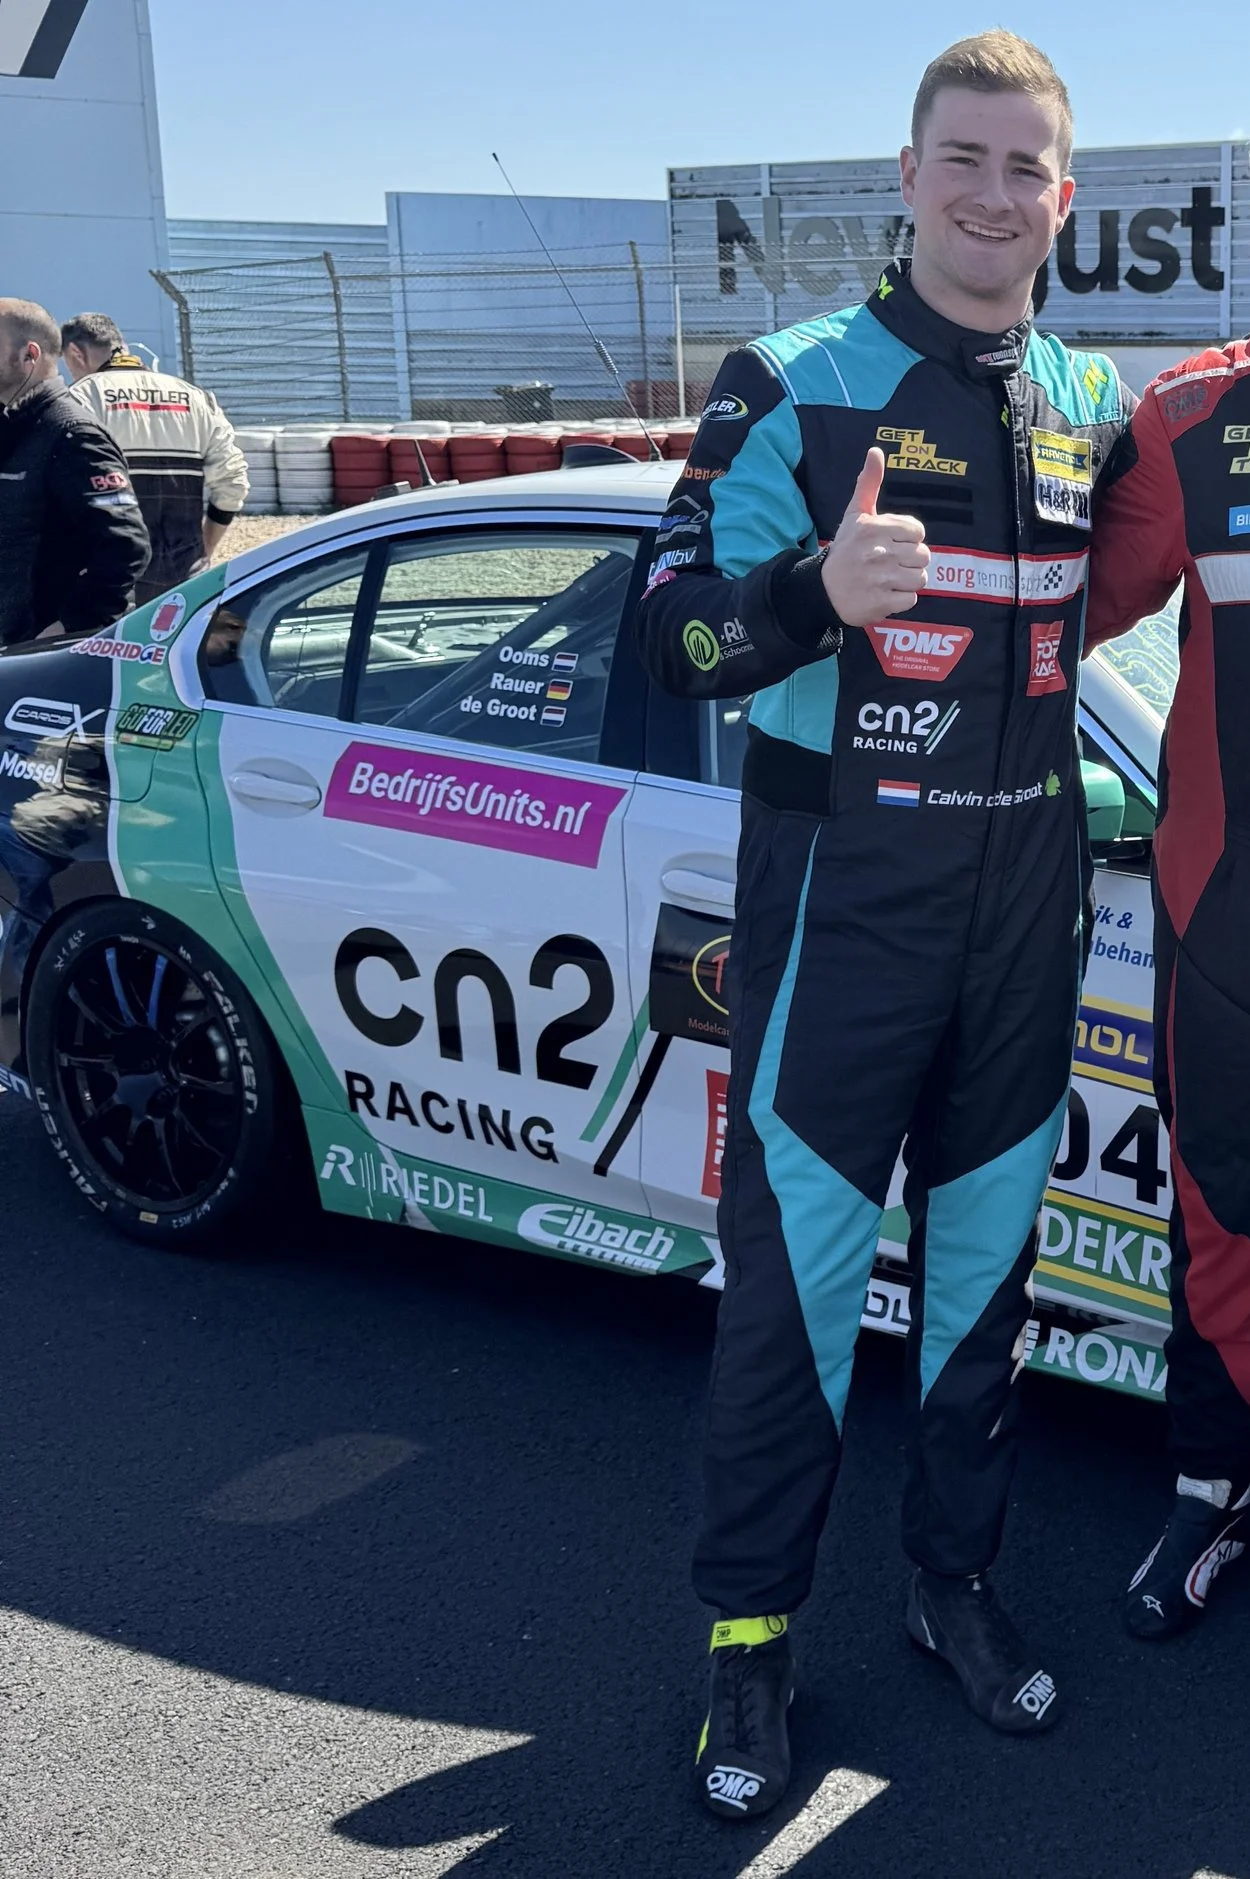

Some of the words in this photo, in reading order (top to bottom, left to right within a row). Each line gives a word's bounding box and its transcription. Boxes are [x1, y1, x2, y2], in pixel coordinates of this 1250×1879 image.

[878, 429, 921, 442] GET
[905, 444, 930, 455] ON
[890, 455, 962, 474] TRACK
[936, 565, 975, 588] sorg
[874, 626, 963, 657] TOMS
[499, 645, 550, 667] Ooms
[490, 673, 544, 695] Rauer
[460, 695, 483, 713] de
[486, 699, 537, 721] Groot
[858, 700, 940, 737] cn2
[852, 736, 918, 754] RACING
[0, 751, 63, 785] Mossel
[349, 762, 592, 836] BedrijfsUnits.nl
[926, 789, 982, 807] Calvin
[1117, 912, 1133, 929] &
[334, 927, 615, 1090] cn2
[344, 1070, 560, 1164] RACING
[380, 1161, 493, 1223] RIEDEL
[517, 1203, 676, 1262] Eibach
[1020, 1672, 1056, 1714] OMP
[706, 1770, 760, 1800] OMP
